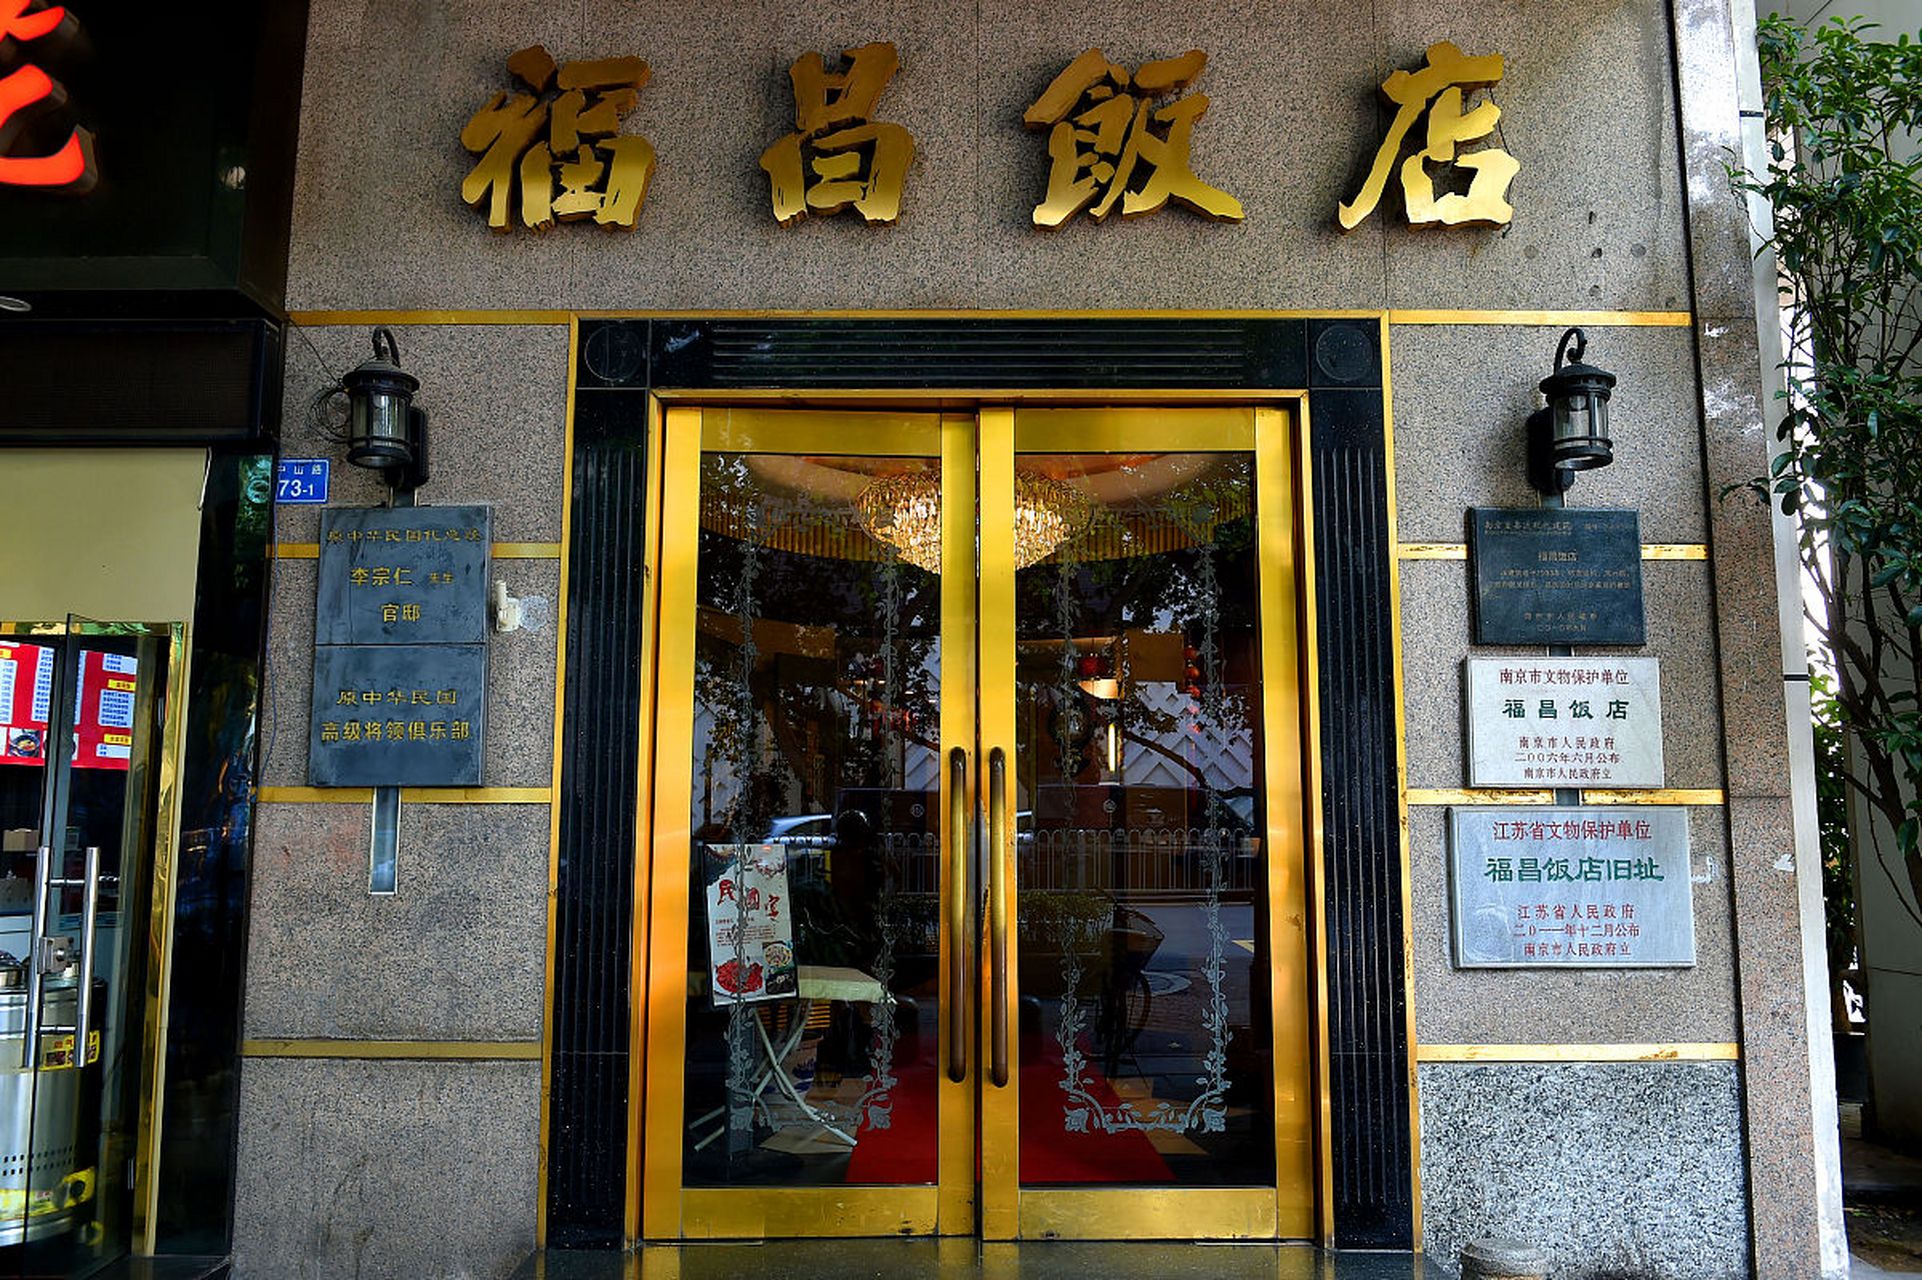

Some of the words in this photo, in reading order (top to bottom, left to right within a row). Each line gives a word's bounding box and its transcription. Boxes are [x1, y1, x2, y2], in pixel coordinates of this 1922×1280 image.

[461, 40, 1522, 235] 福昌飯店
[278, 479, 314, 497] 73-1
[351, 567, 413, 587] 李宗仁
[429, 572, 455, 585] 先生
[381, 604, 421, 622] 官邸
[1500, 668, 1630, 685] 南京市文物保护单位
[337, 689, 457, 706] 原中华民国
[1502, 699, 1630, 720] 福昌饭店
[321, 720, 470, 742] 高级将领俱乐部
[1519, 736, 1616, 749] 南京市人民政府
[1523, 767, 1613, 779] 南京市人民政府立
[1493, 821, 1651, 841] 江苏省文物保护单位
[1484, 856, 1665, 883] 福昌饭店旧址
[1517, 904, 1635, 920] 江苏省人民政府
[1524, 942, 1632, 957] 南京市人民政府立
